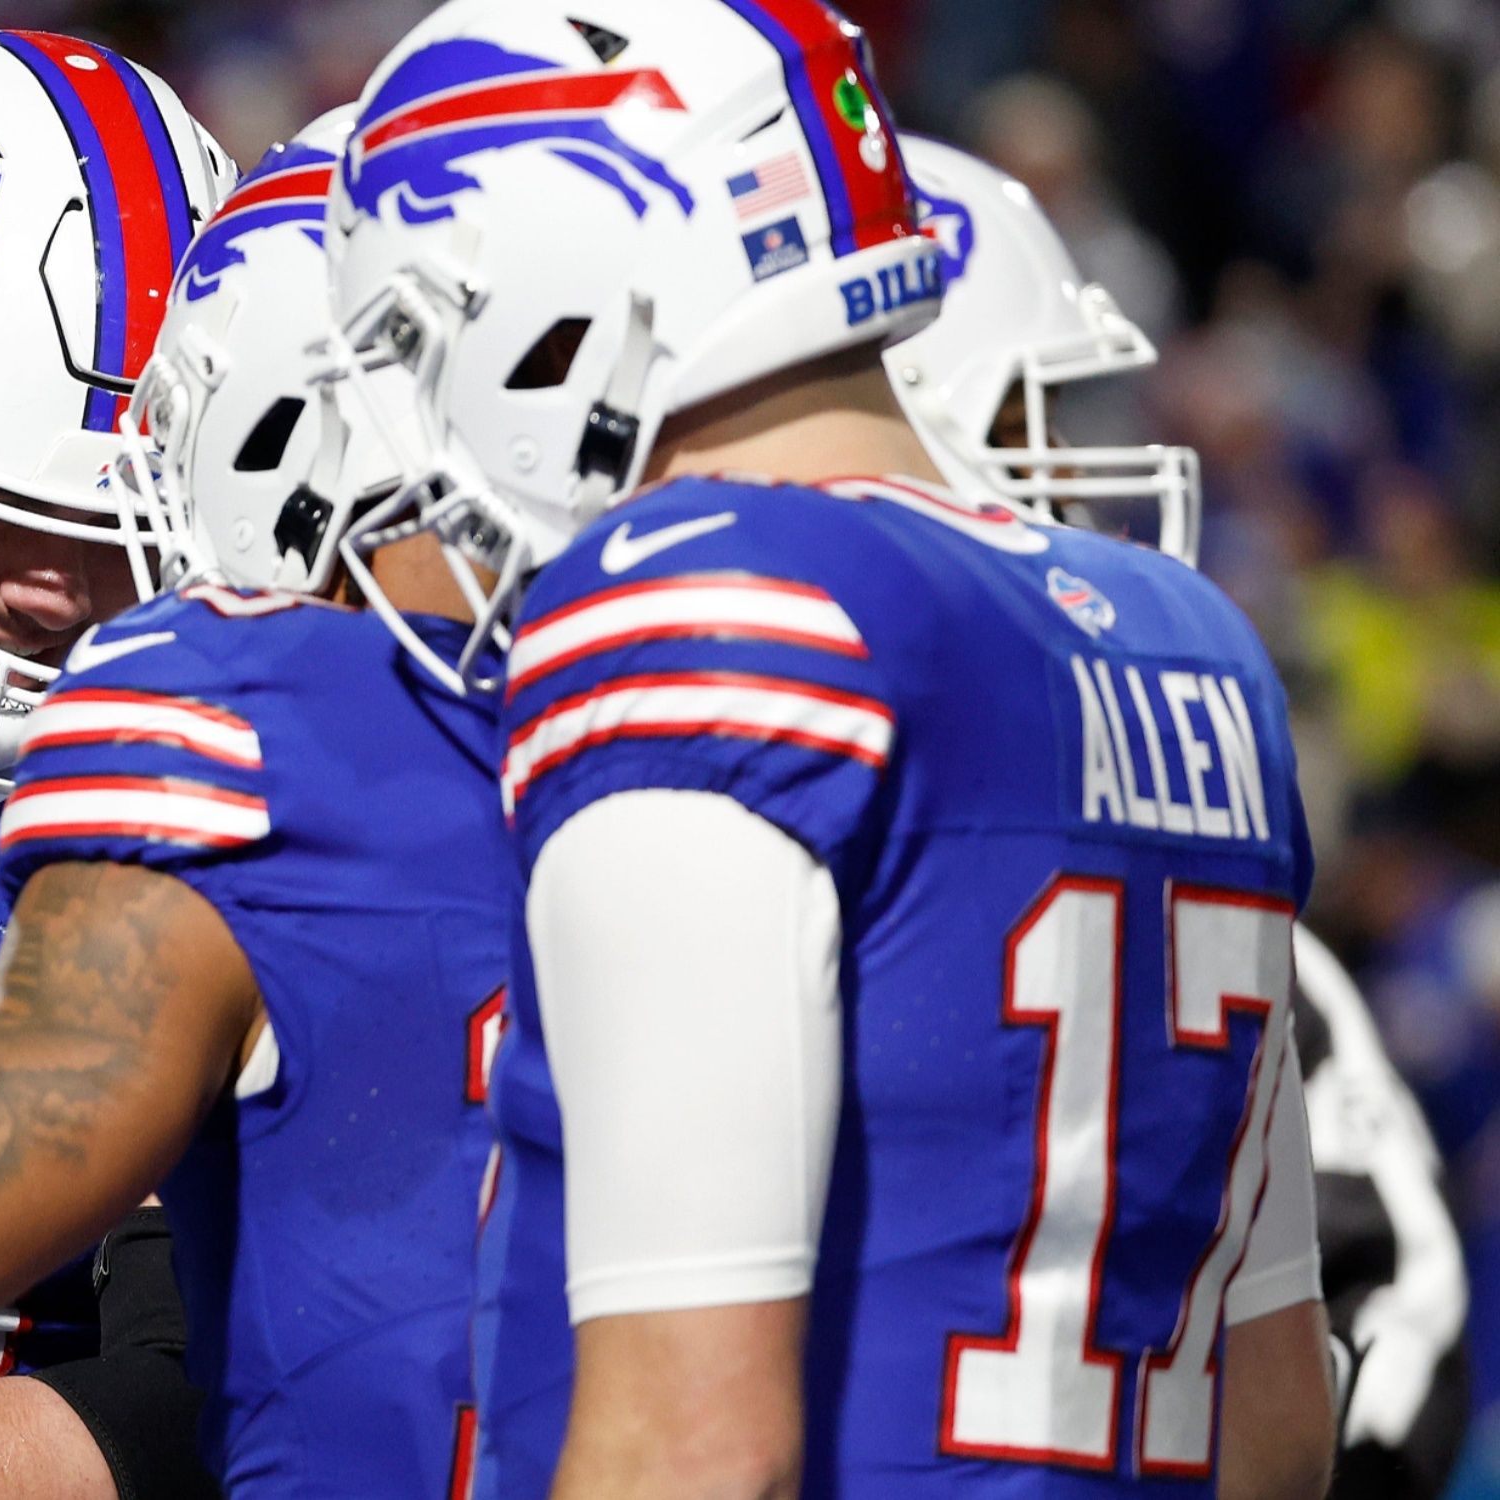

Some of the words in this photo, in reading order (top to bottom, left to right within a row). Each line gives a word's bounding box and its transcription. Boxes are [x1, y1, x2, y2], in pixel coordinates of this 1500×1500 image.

[839, 254, 941, 326] BILL
[1070, 653, 1270, 841] ALLEN
[938, 871, 1297, 1479] 17
